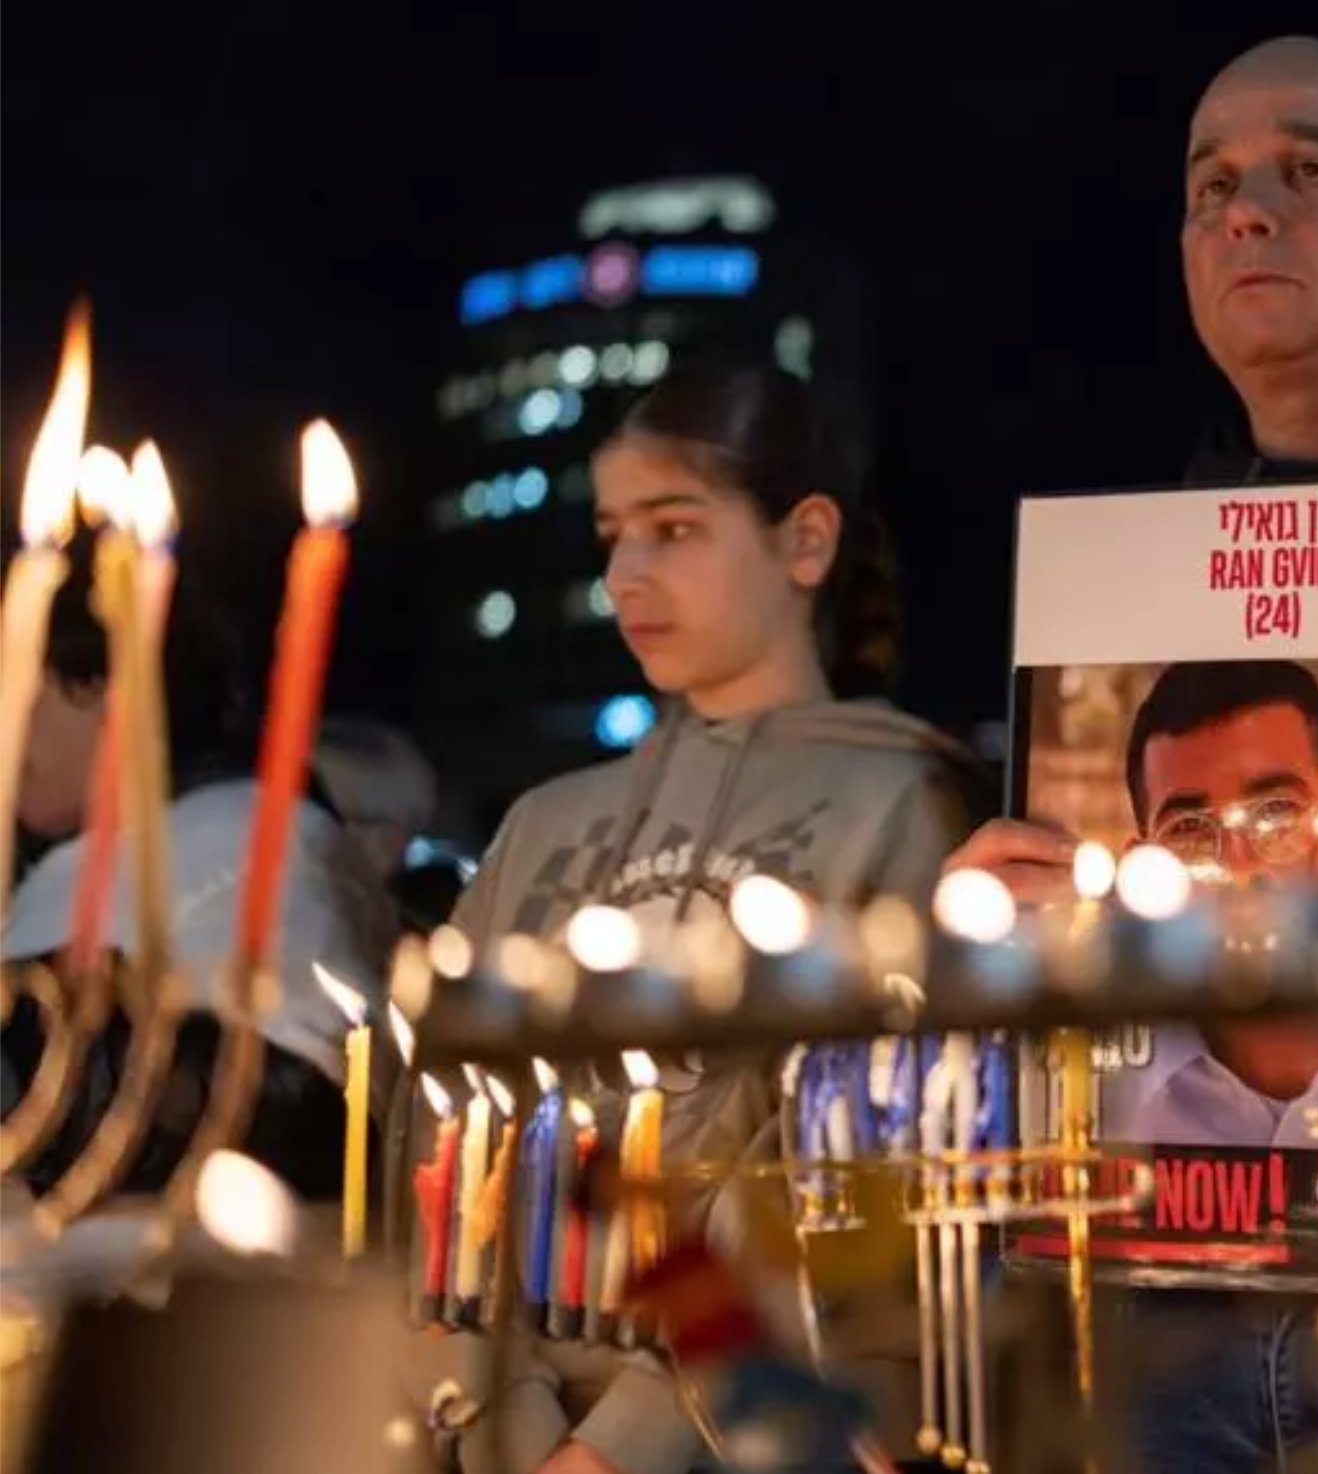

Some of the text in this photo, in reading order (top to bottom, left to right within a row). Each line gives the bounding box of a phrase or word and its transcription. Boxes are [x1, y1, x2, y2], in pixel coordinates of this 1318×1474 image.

[1219, 501, 1299, 542] גואילי
[1209, 549, 1264, 590] RAN
[1246, 591, 1301, 640] (24)
[1154, 1152, 1287, 1234] NOW!
